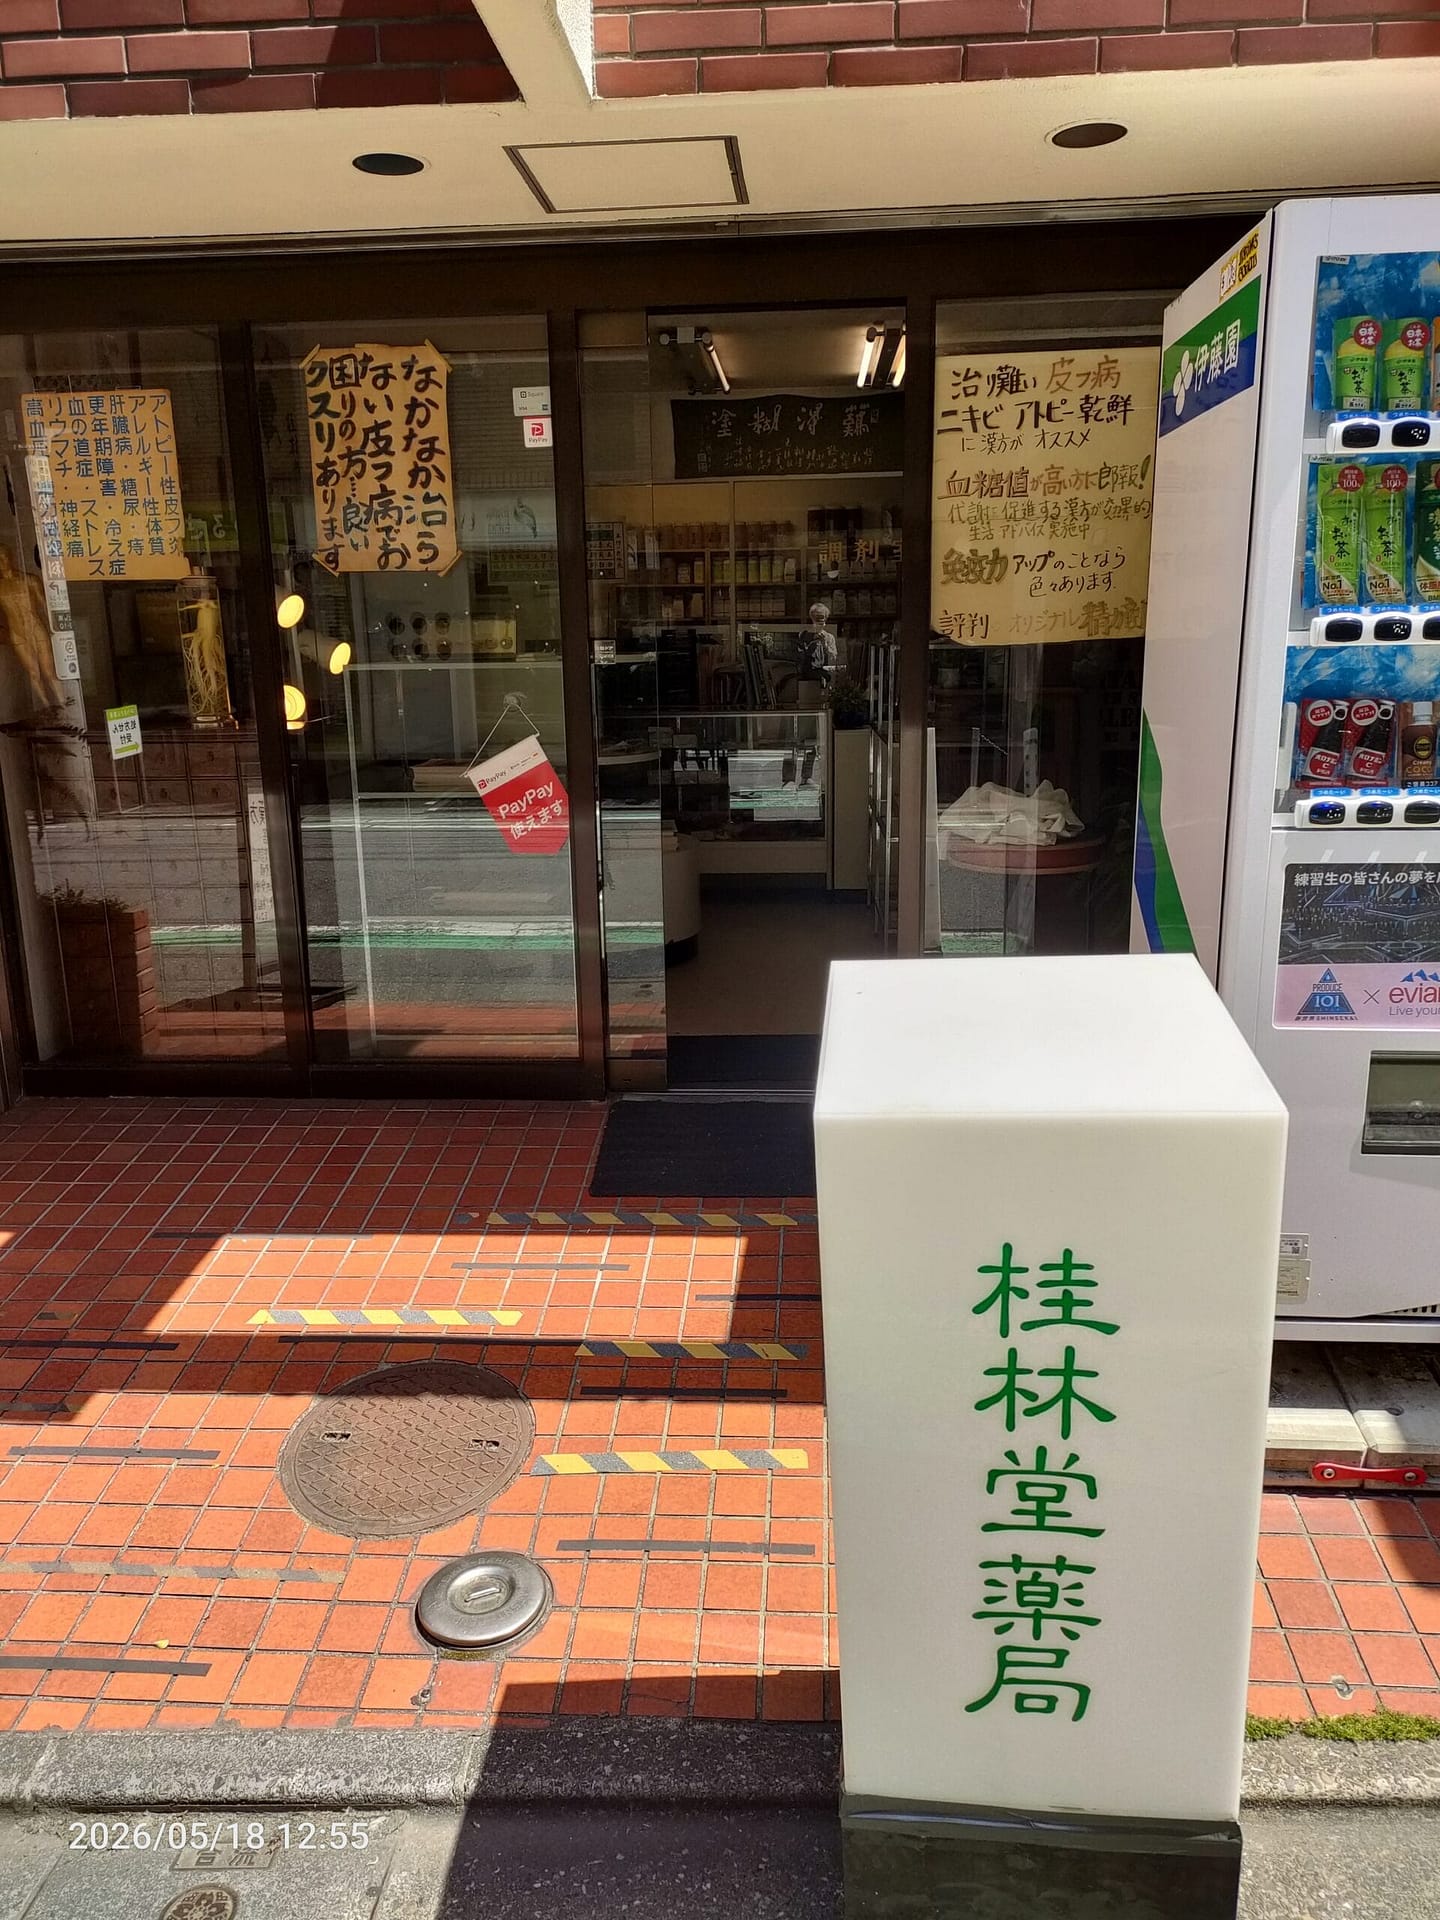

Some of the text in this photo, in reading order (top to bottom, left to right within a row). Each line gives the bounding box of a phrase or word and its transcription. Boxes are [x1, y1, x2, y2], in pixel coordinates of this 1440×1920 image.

[1194, 318, 1241, 392] 伊藤園
[1034, 427, 1092, 450] オススメ
[87, 395, 127, 576] 更年期障害・冷え症
[128, 395, 166, 556] アレルギー性体質
[1322, 580, 1342, 591] No.1
[1369, 578, 1390, 590] No.1
[485, 770, 507, 785] PayPay
[498, 782, 554, 819] PayPay
[510, 798, 564, 840] 使えます
[1294, 870, 1440, 887] 練習生の皆さんの夢を
[1313, 983, 1343, 992] PRODUCE
[1314, 995, 1340, 1008] 101
[1389, 1006, 1413, 1016] Live
[964, 1242, 1120, 1722] 桂林堂薬局
